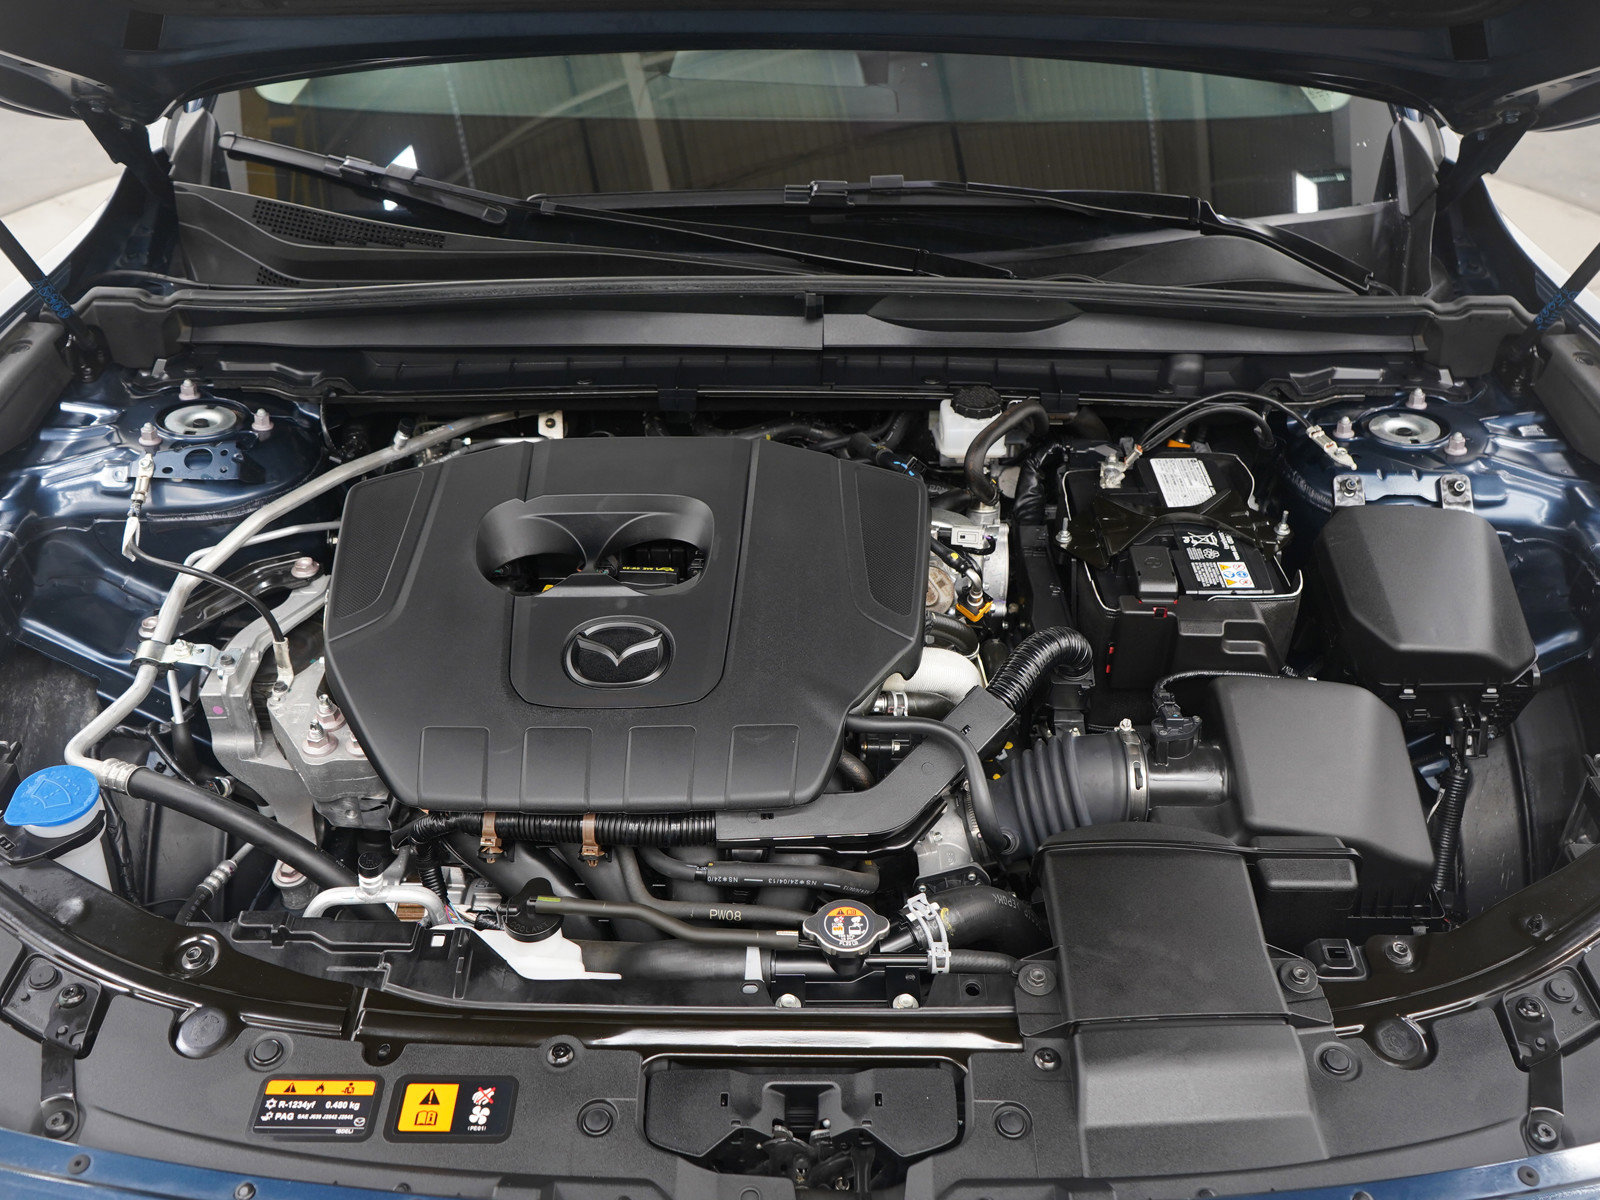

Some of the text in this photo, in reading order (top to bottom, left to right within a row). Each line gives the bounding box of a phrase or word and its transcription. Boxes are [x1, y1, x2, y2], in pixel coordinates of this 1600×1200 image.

[709, 908, 742, 921] PW08
[278, 1100, 361, 1111] R-1234yf 0.480 kg
[274, 1112, 295, 1120] PAG
